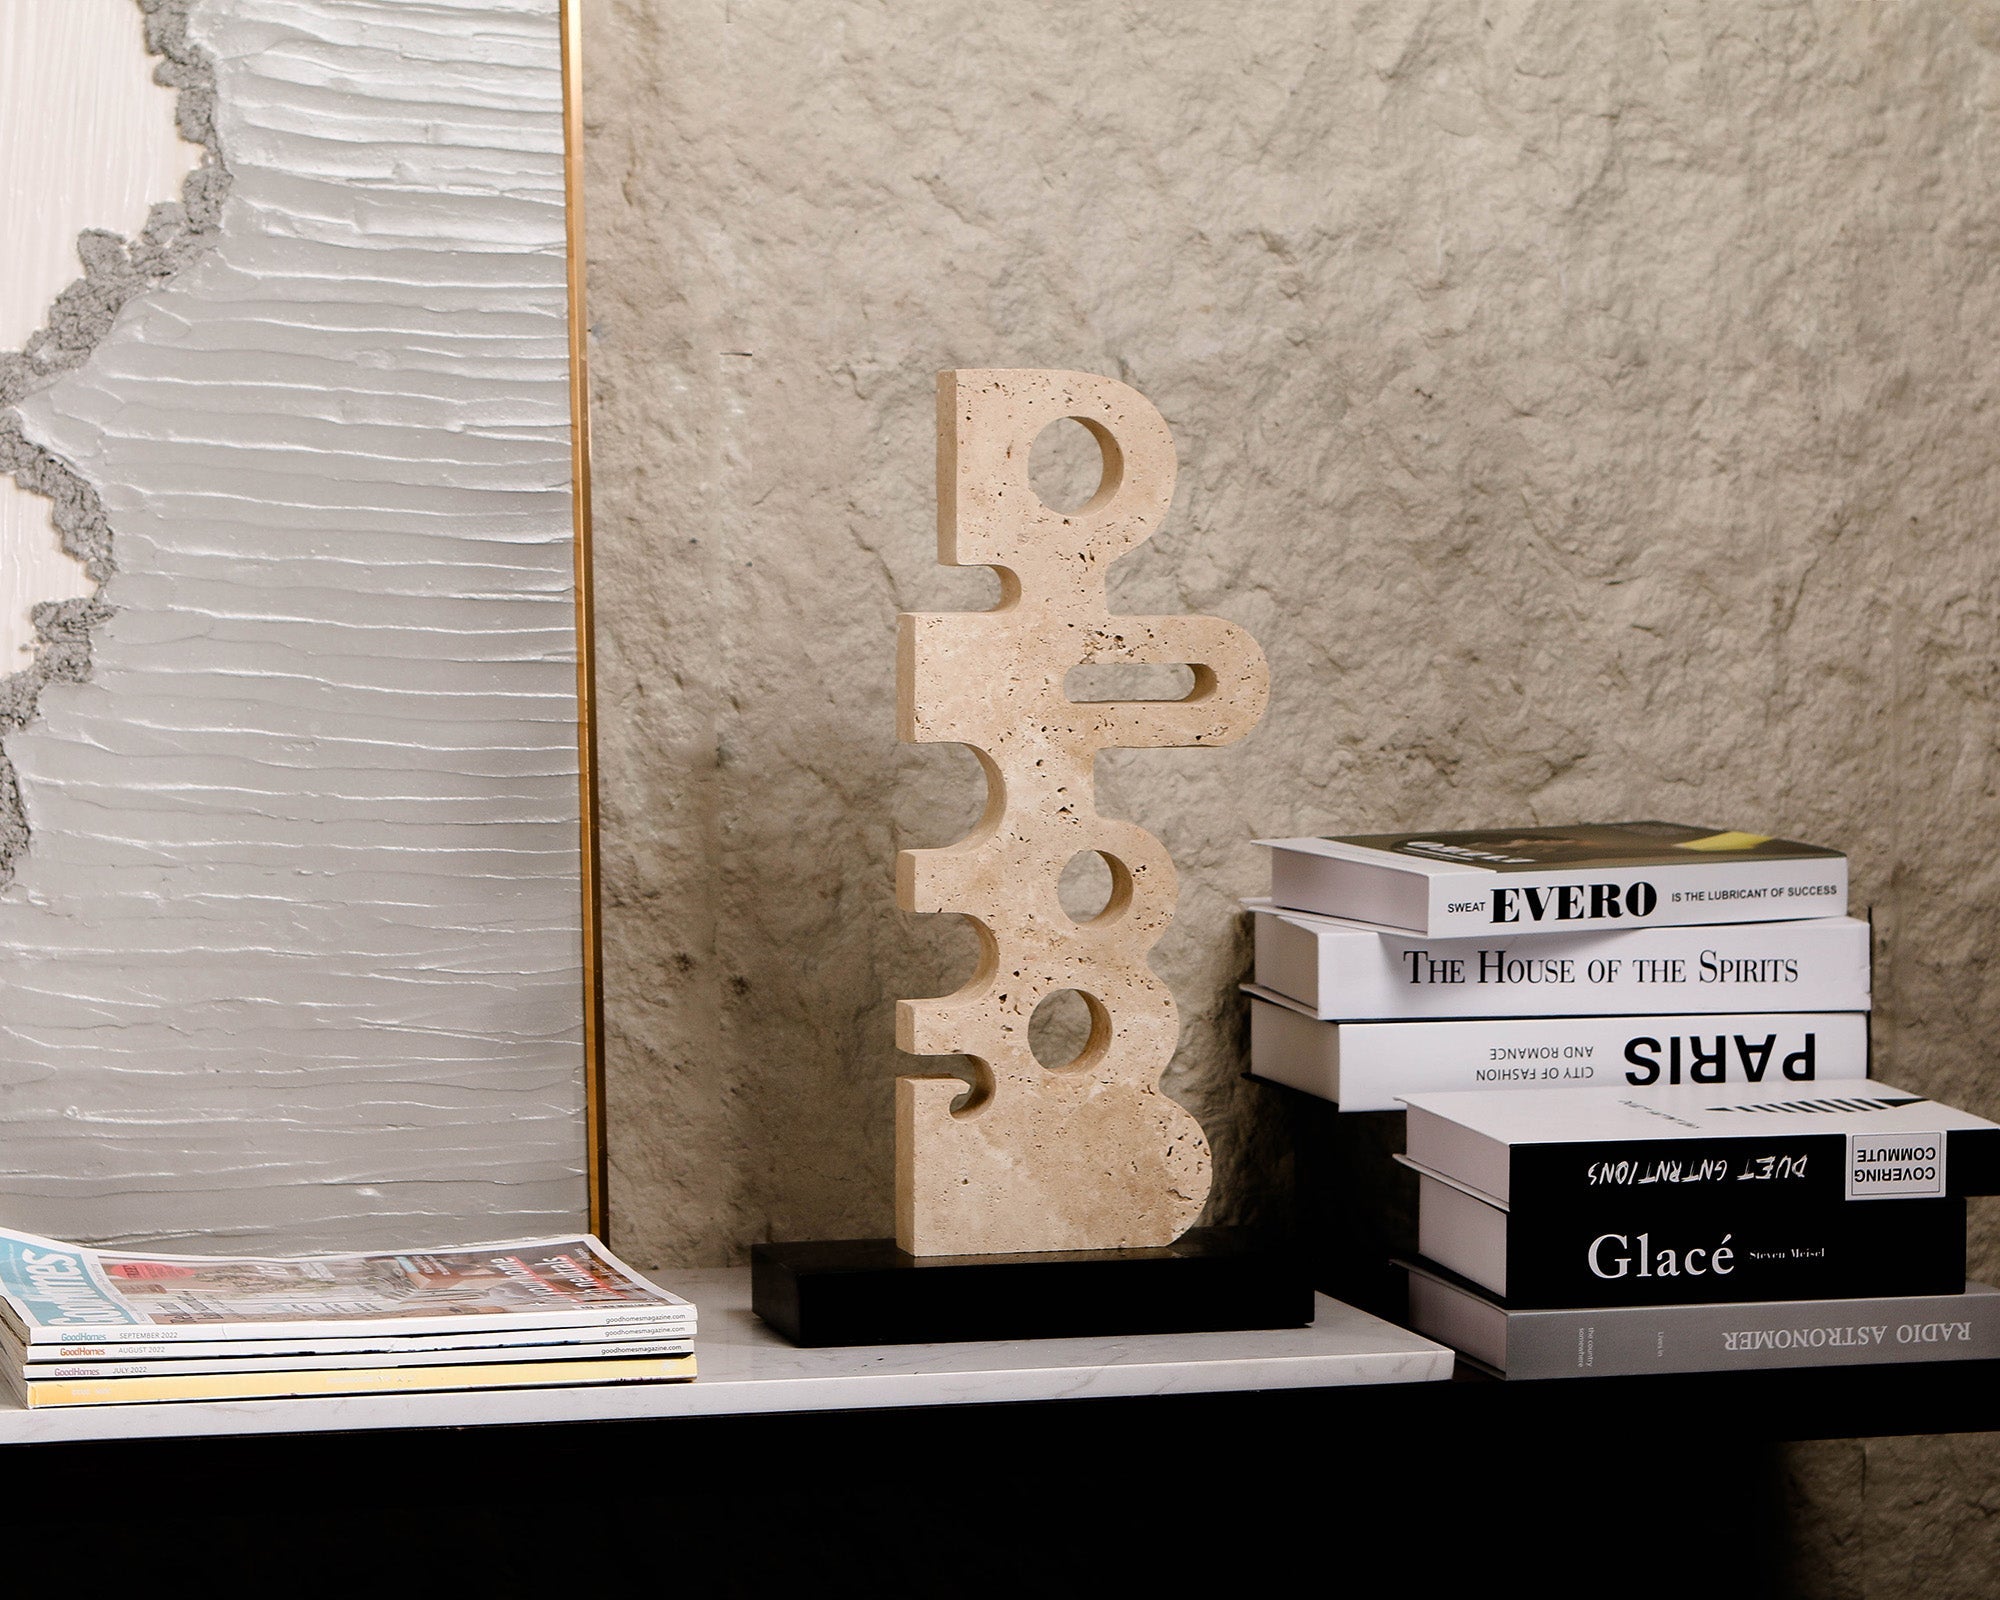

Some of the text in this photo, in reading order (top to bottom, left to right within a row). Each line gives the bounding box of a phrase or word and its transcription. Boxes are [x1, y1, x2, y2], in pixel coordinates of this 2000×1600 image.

[1447, 882, 1838, 924] SWEAT EVERO IS THE LUBRICANT OF SUCCESS
[1489, 1046, 1594, 1061] AND ROMANCE
[1624, 1033, 1815, 1086] PARIS
[1476, 1066, 1594, 1082] CITY OF FASHION
[1856, 1146, 1937, 1163] COMMUTE
[1854, 1166, 1936, 1183] COVERING
[1587, 1232, 1735, 1279] Glacé
[605, 1313, 686, 1324] goodhomesmagazine.com
[61, 1331, 178, 1342] GoodHomes SEPTEMBER 2022
[604, 1326, 686, 1337] goodhomesmagazine.com
[1721, 1321, 1972, 1351] RADIO ASTRONOMER
[60, 1347, 106, 1356] GoodHomes
[600, 1344, 682, 1355] goodhomesmagazine.com
[54, 1365, 148, 1377] GoodHomes JULY 2022
